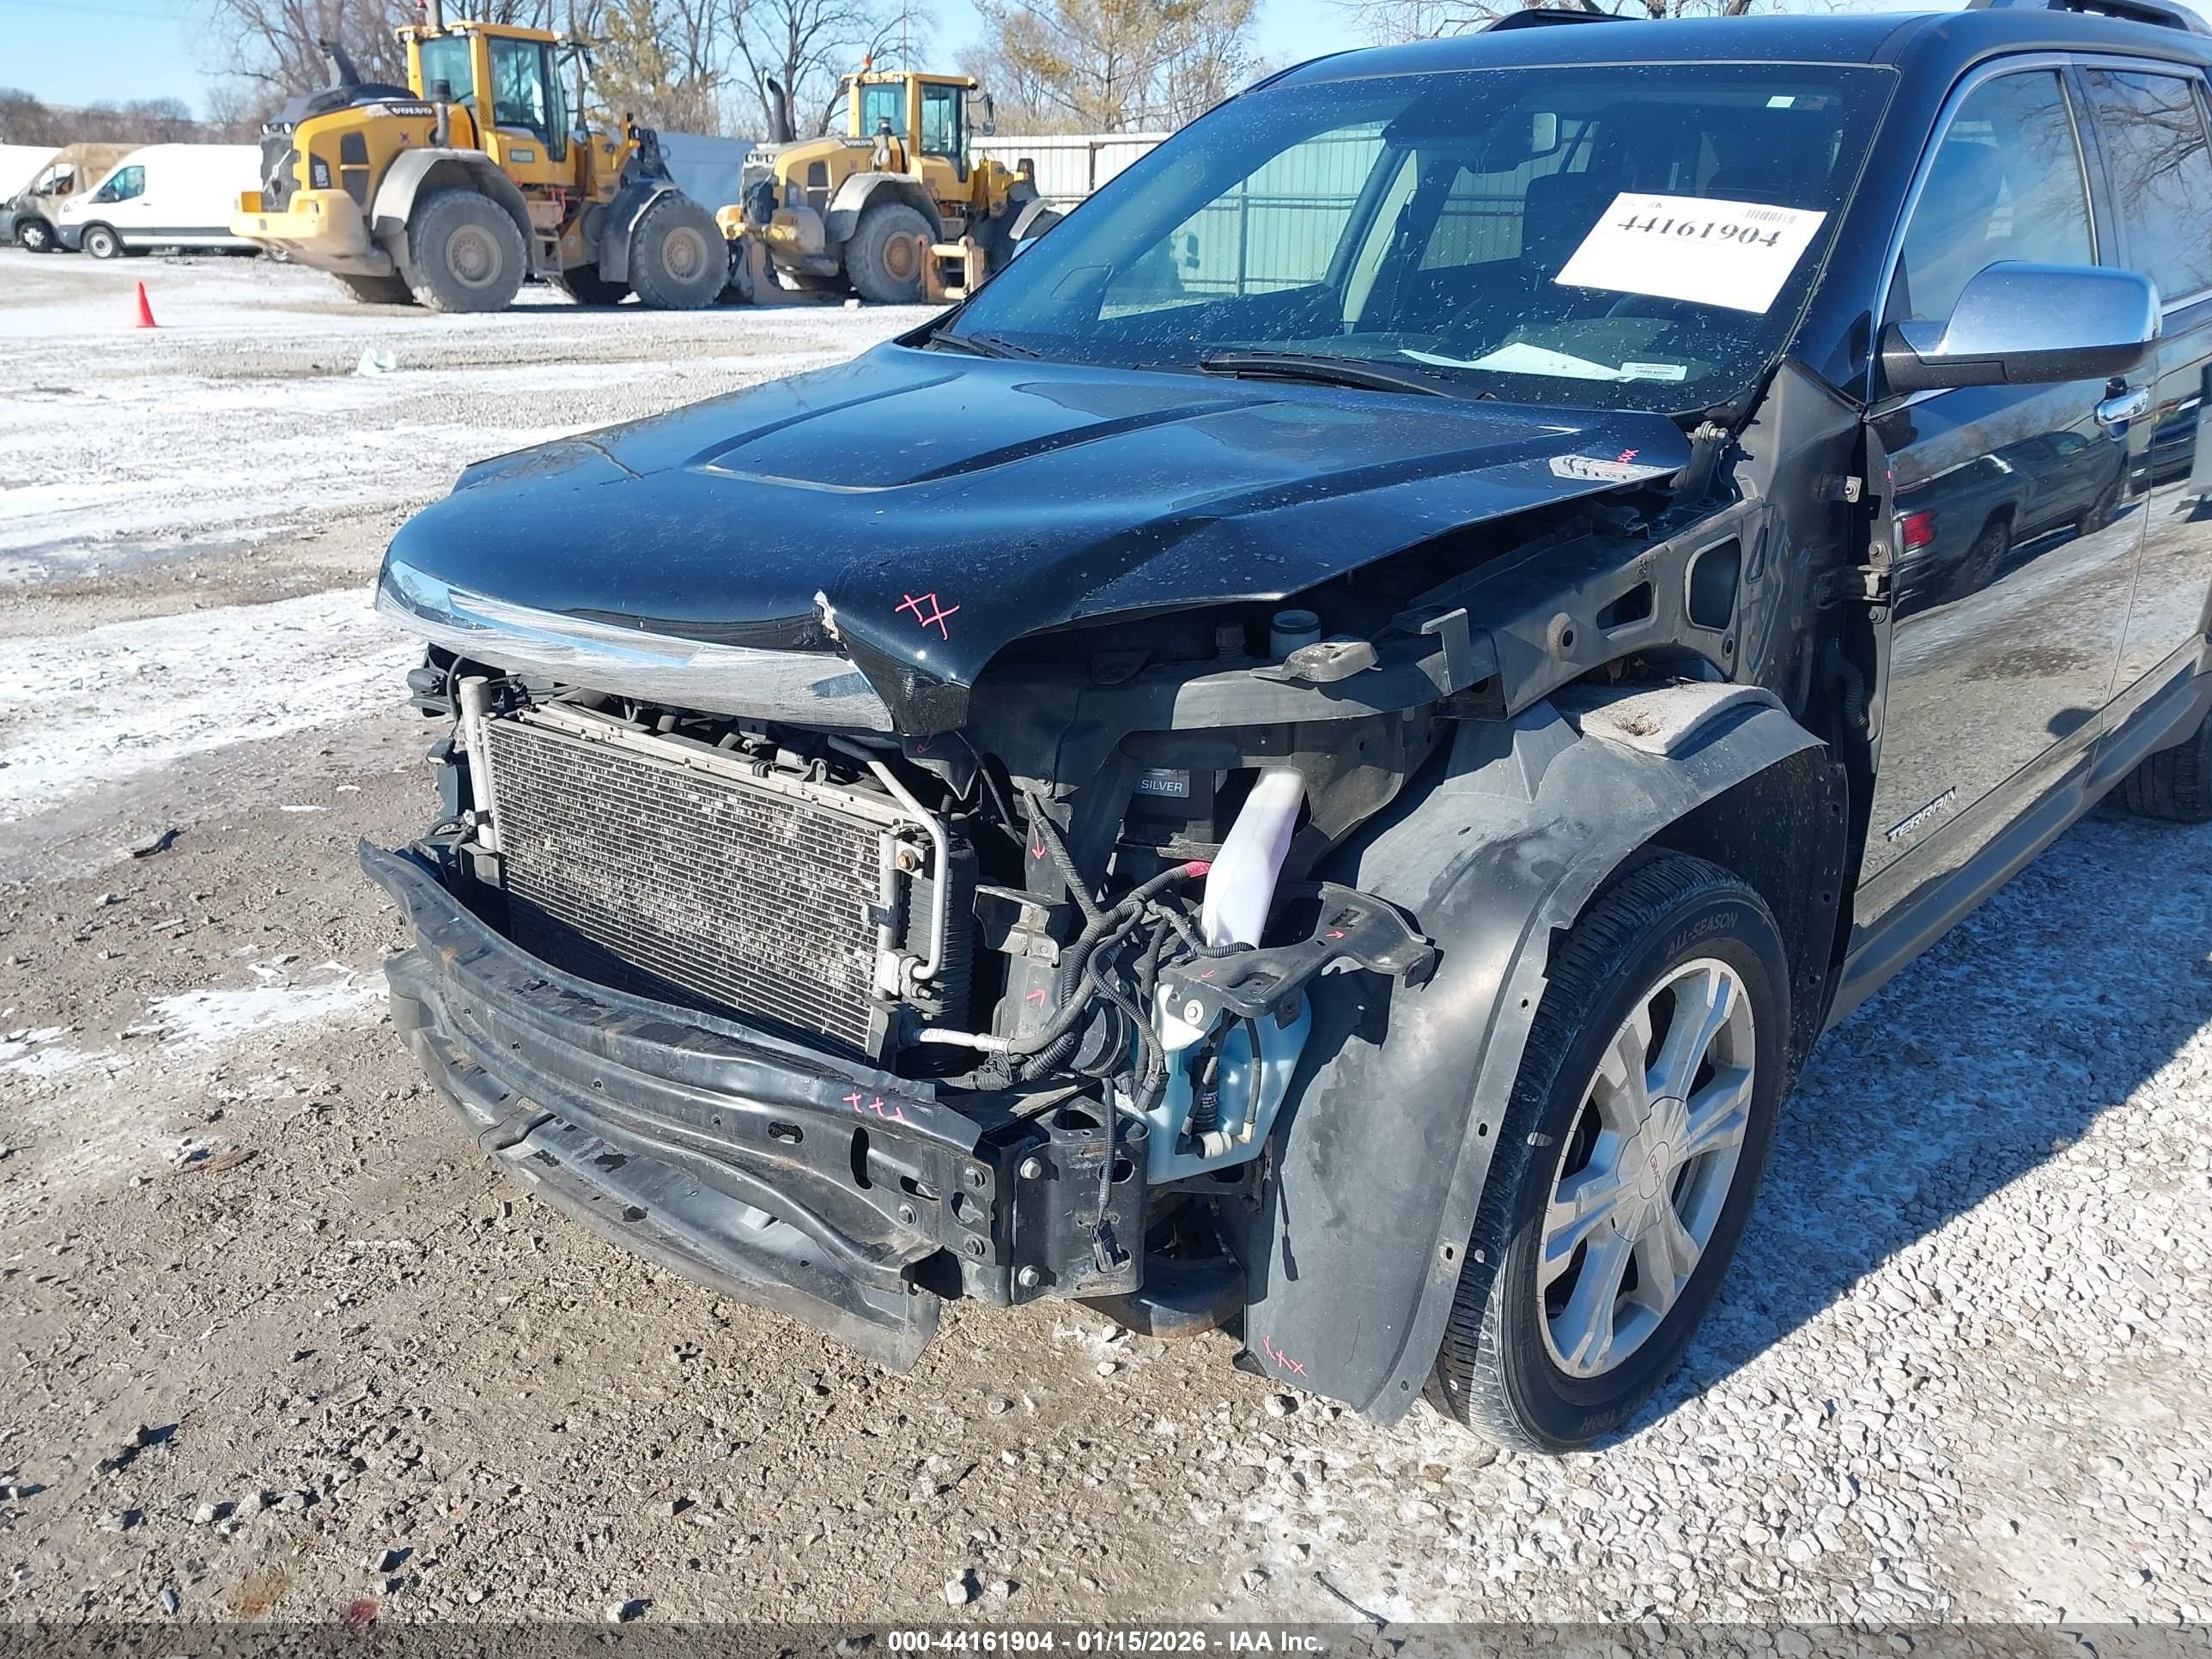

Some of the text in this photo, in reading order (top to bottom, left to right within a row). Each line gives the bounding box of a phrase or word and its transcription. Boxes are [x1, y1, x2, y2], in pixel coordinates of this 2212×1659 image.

[391, 106, 434, 116] VOLVO
[1617, 214, 1783, 248] 44161904
[1140, 780, 1183, 793] SILVER
[1887, 787, 1959, 842] TERRAIN
[1666, 912, 1739, 960] ALL-SEASON
[1649, 1153, 1662, 1188] GMC
